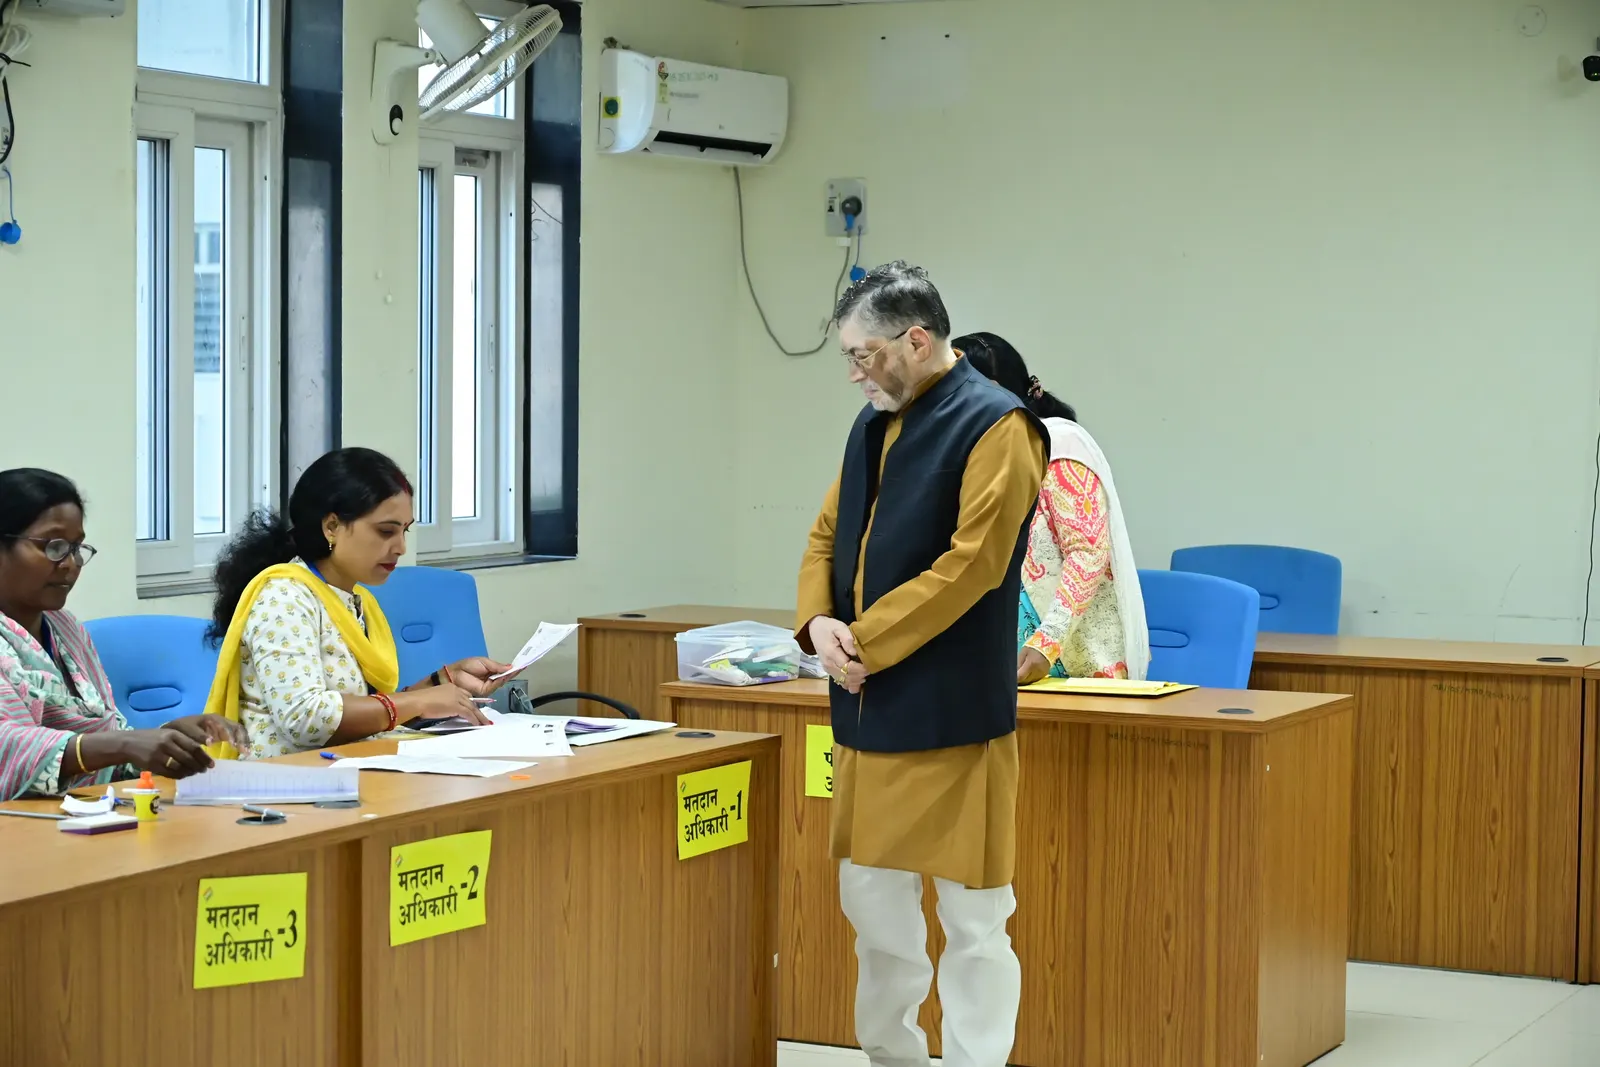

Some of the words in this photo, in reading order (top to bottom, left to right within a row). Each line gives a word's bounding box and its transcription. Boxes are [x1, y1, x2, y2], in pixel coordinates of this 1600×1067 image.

[683, 789, 718, 813] मतदान
[684, 808, 728, 842] अधिकारी
[730, 790, 742, 820] -1
[398, 864, 444, 891] मतदान
[399, 885, 458, 926] अधिकारी
[460, 865, 479, 900] -2
[206, 904, 260, 931] मतदान
[205, 929, 274, 966] अधिकारी
[277, 909, 298, 948] -3
